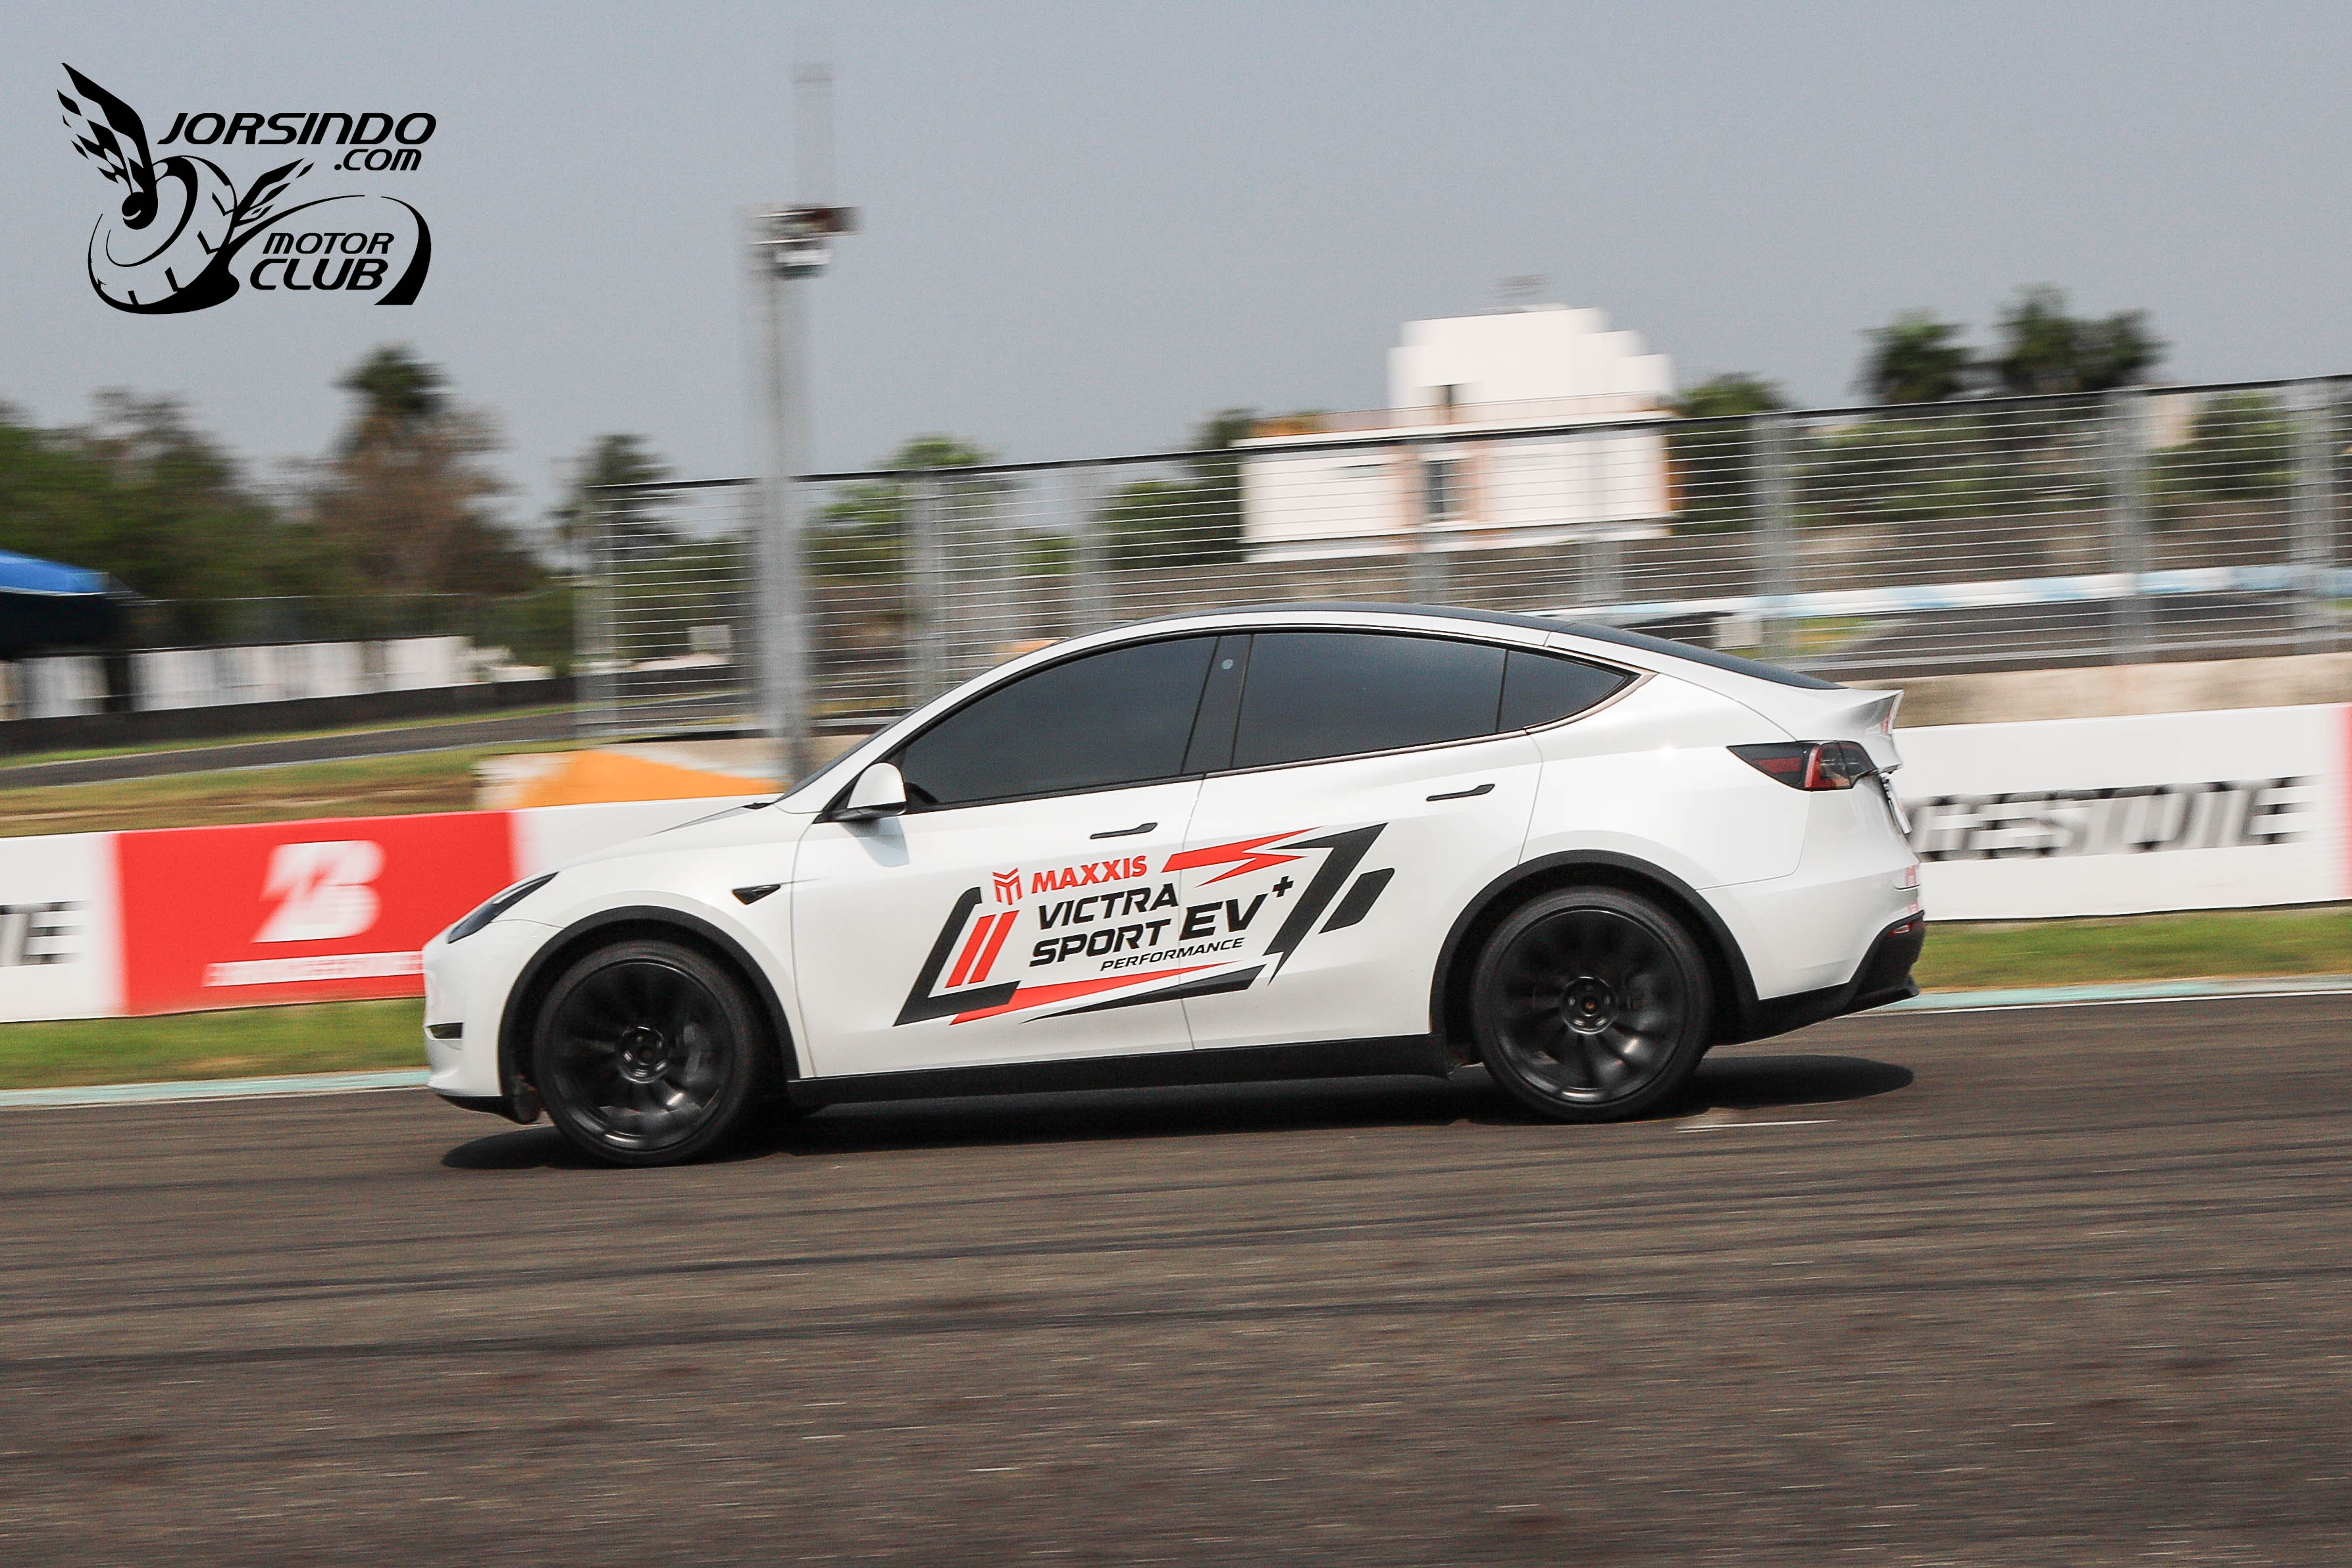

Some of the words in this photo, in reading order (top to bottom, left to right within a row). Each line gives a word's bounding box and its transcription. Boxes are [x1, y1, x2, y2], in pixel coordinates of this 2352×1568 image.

[1031, 855, 1148, 894] MAXXIS
[1038, 882, 1180, 930] VICTRA
[1029, 918, 1172, 967] SPORT
[1100, 937, 1246, 972] PERFORMANCE
